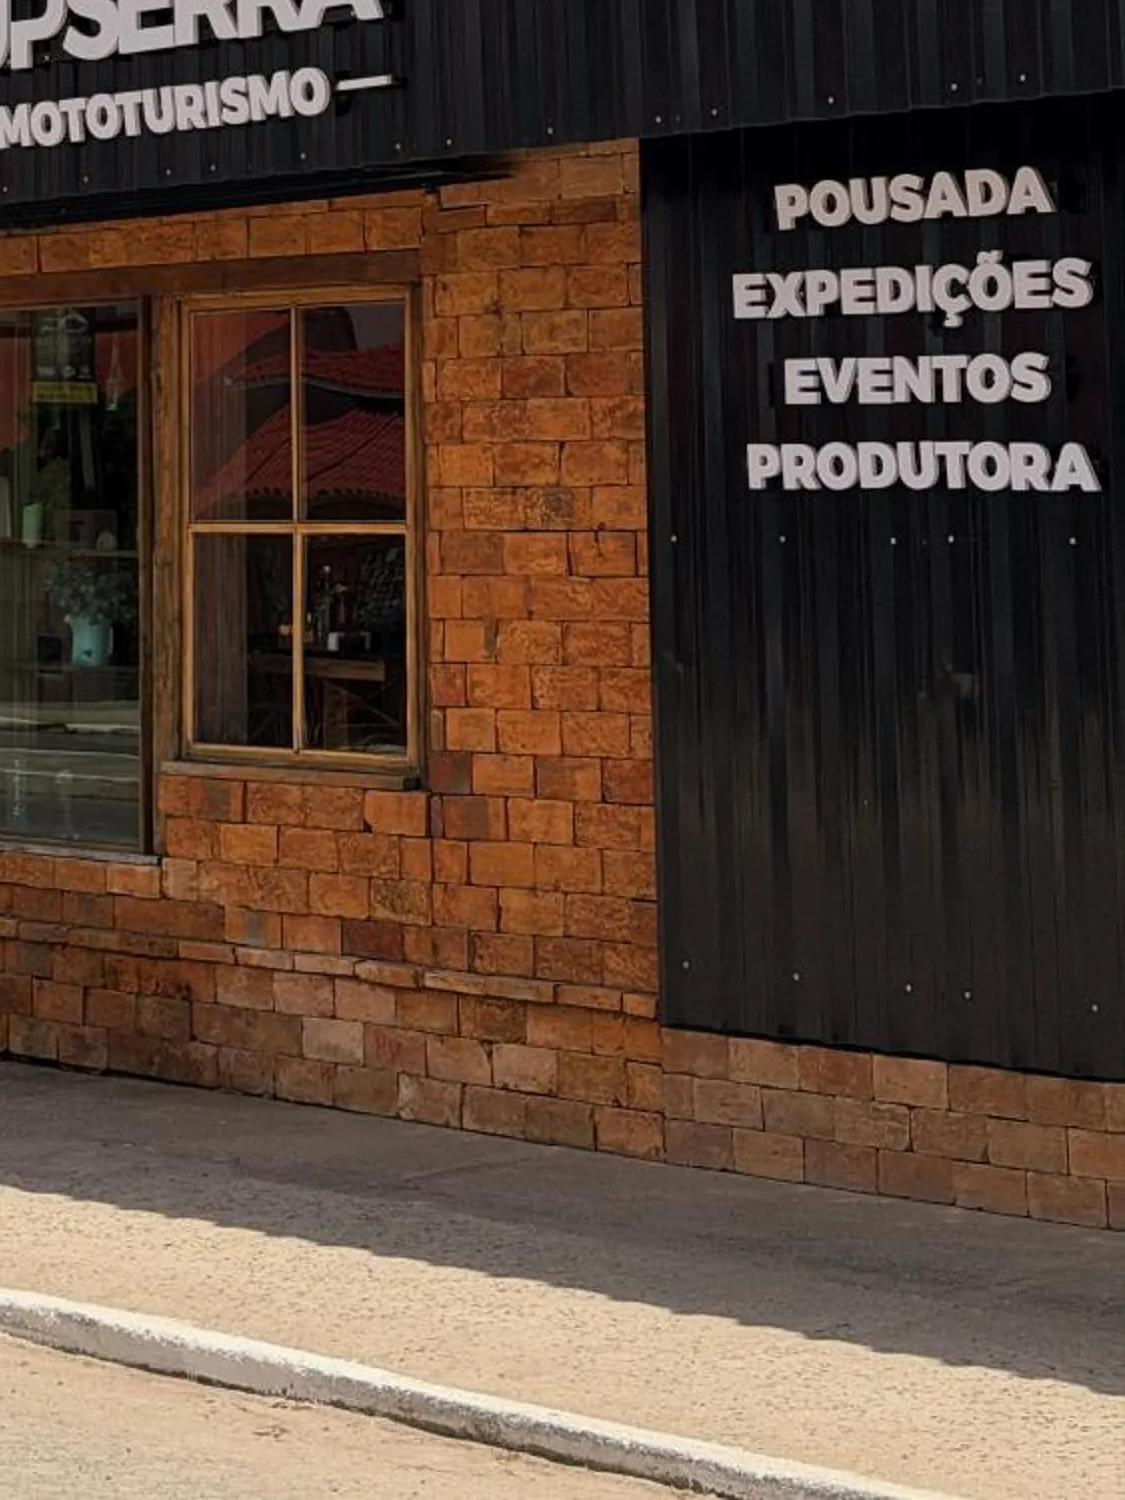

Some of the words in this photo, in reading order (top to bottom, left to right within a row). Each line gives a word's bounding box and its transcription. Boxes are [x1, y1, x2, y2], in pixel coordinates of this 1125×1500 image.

[774, 166, 1055, 231] POUSADA
[732, 250, 1094, 328] EXPEDIÇÕES
[784, 352, 1052, 405] EVENTOS
[746, 440, 1102, 492] PRODUTORA
